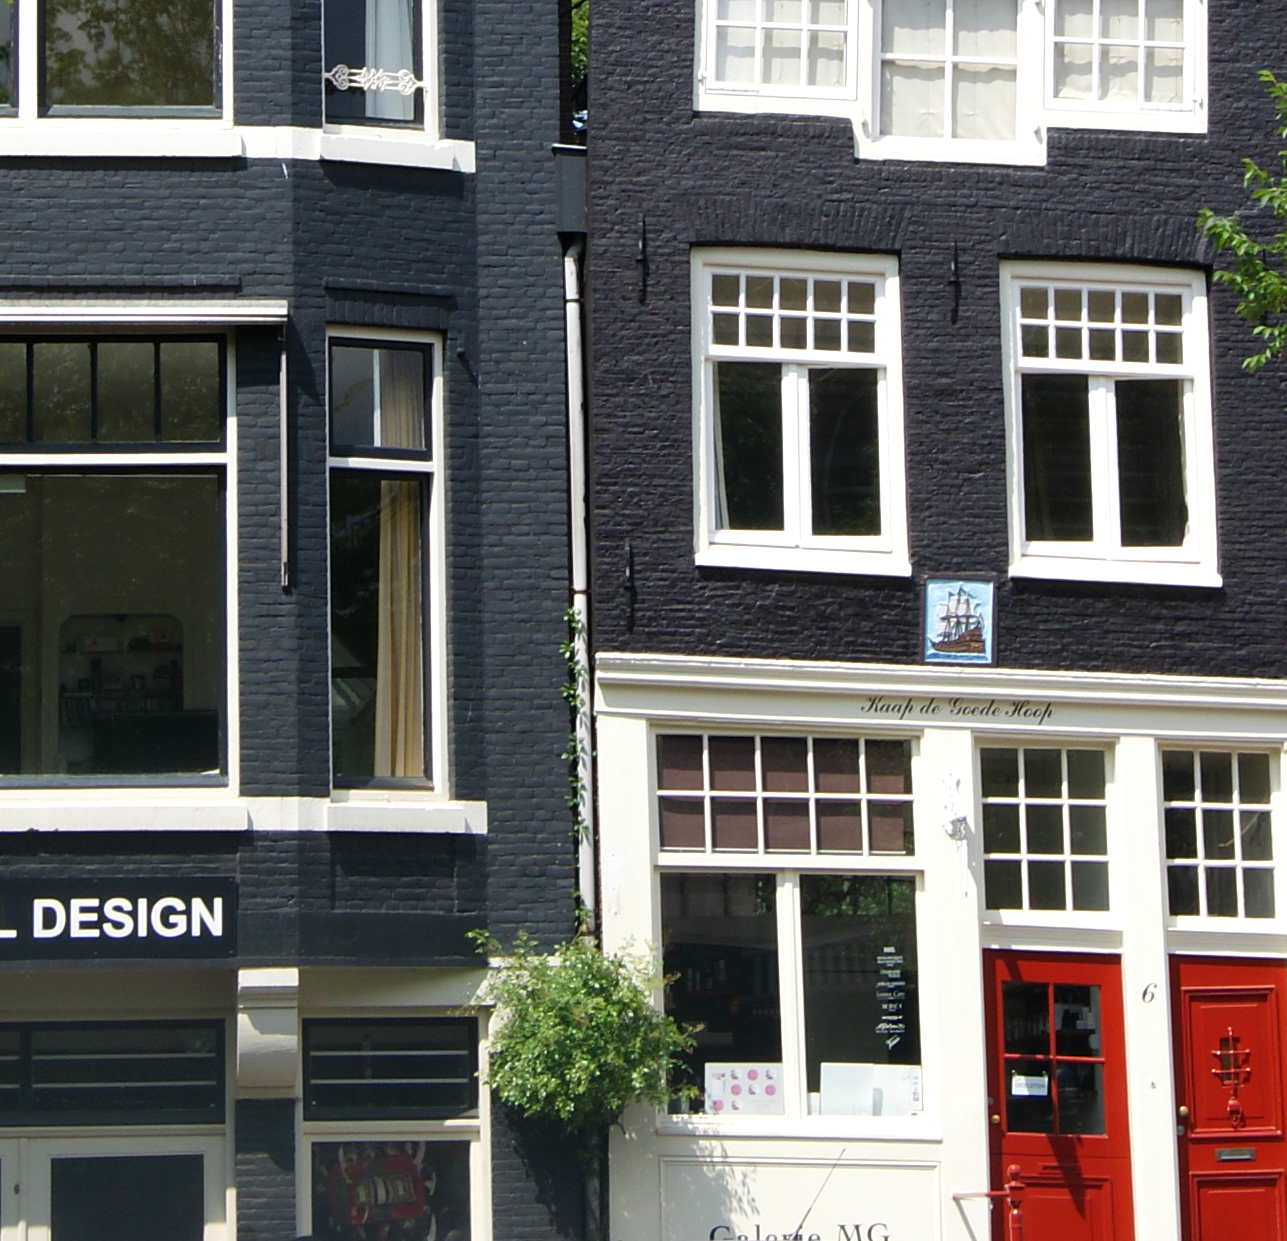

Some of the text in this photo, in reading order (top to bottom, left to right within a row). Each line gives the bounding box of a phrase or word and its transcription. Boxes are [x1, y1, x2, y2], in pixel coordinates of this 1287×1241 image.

[860, 695, 1056, 726] Kaap de Goede Hoop
[32, 896, 224, 940] DESIGN
[1142, 982, 1158, 1004] 6
